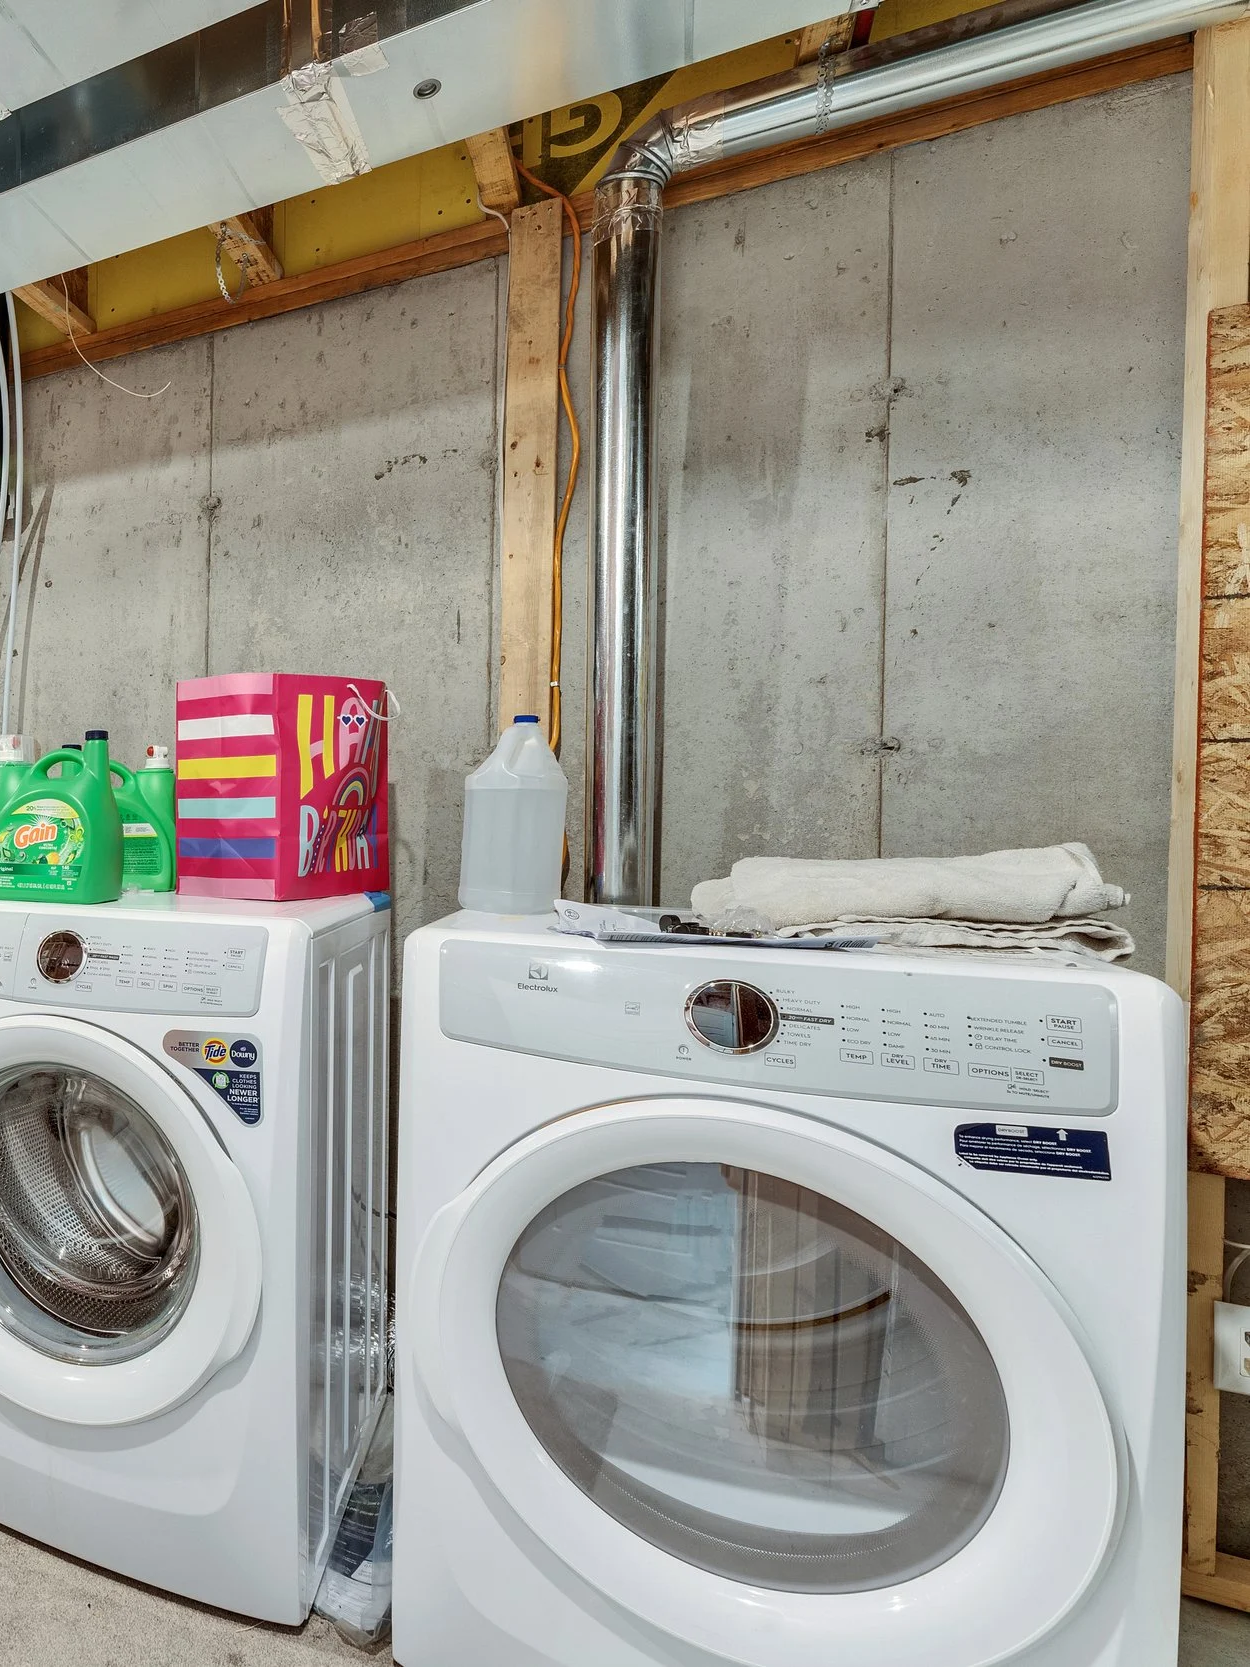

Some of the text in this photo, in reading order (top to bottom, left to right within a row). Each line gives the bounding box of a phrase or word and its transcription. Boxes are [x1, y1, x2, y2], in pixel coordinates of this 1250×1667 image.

[14, 822, 58, 849] Gain
[517, 983, 558, 992] Electrolux
[205, 1044, 227, 1060] Tide
[231, 1050, 255, 1060] Downy
[766, 1056, 794, 1065] CYCLES
[972, 1068, 1009, 1077] OPTIONS
